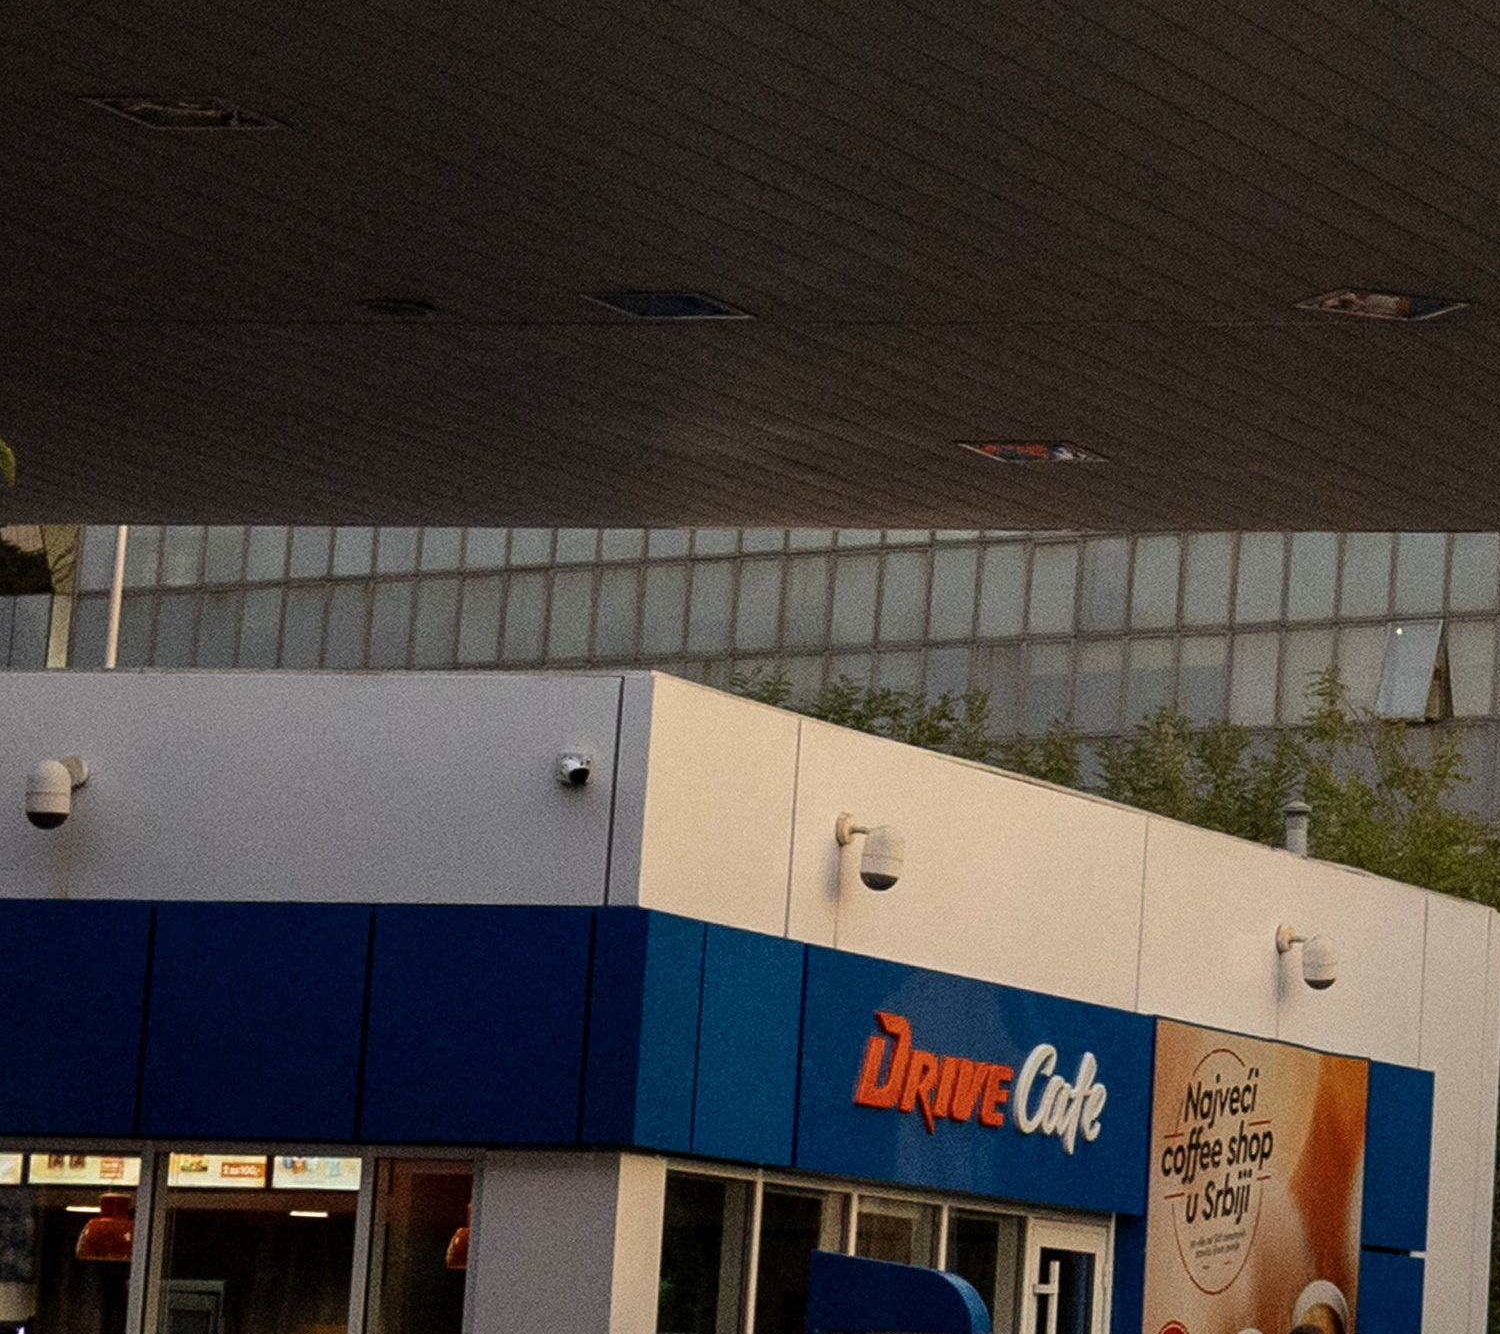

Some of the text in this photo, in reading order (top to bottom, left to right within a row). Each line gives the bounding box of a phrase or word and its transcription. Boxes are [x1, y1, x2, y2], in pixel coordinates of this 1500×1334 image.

[853, 1010, 1014, 1135] DRIVE
[1183, 1067, 1259, 1130] Najveći
[1160, 1120, 1274, 1185] coffee shop
[1185, 1169, 1253, 1225] u Srbiji
